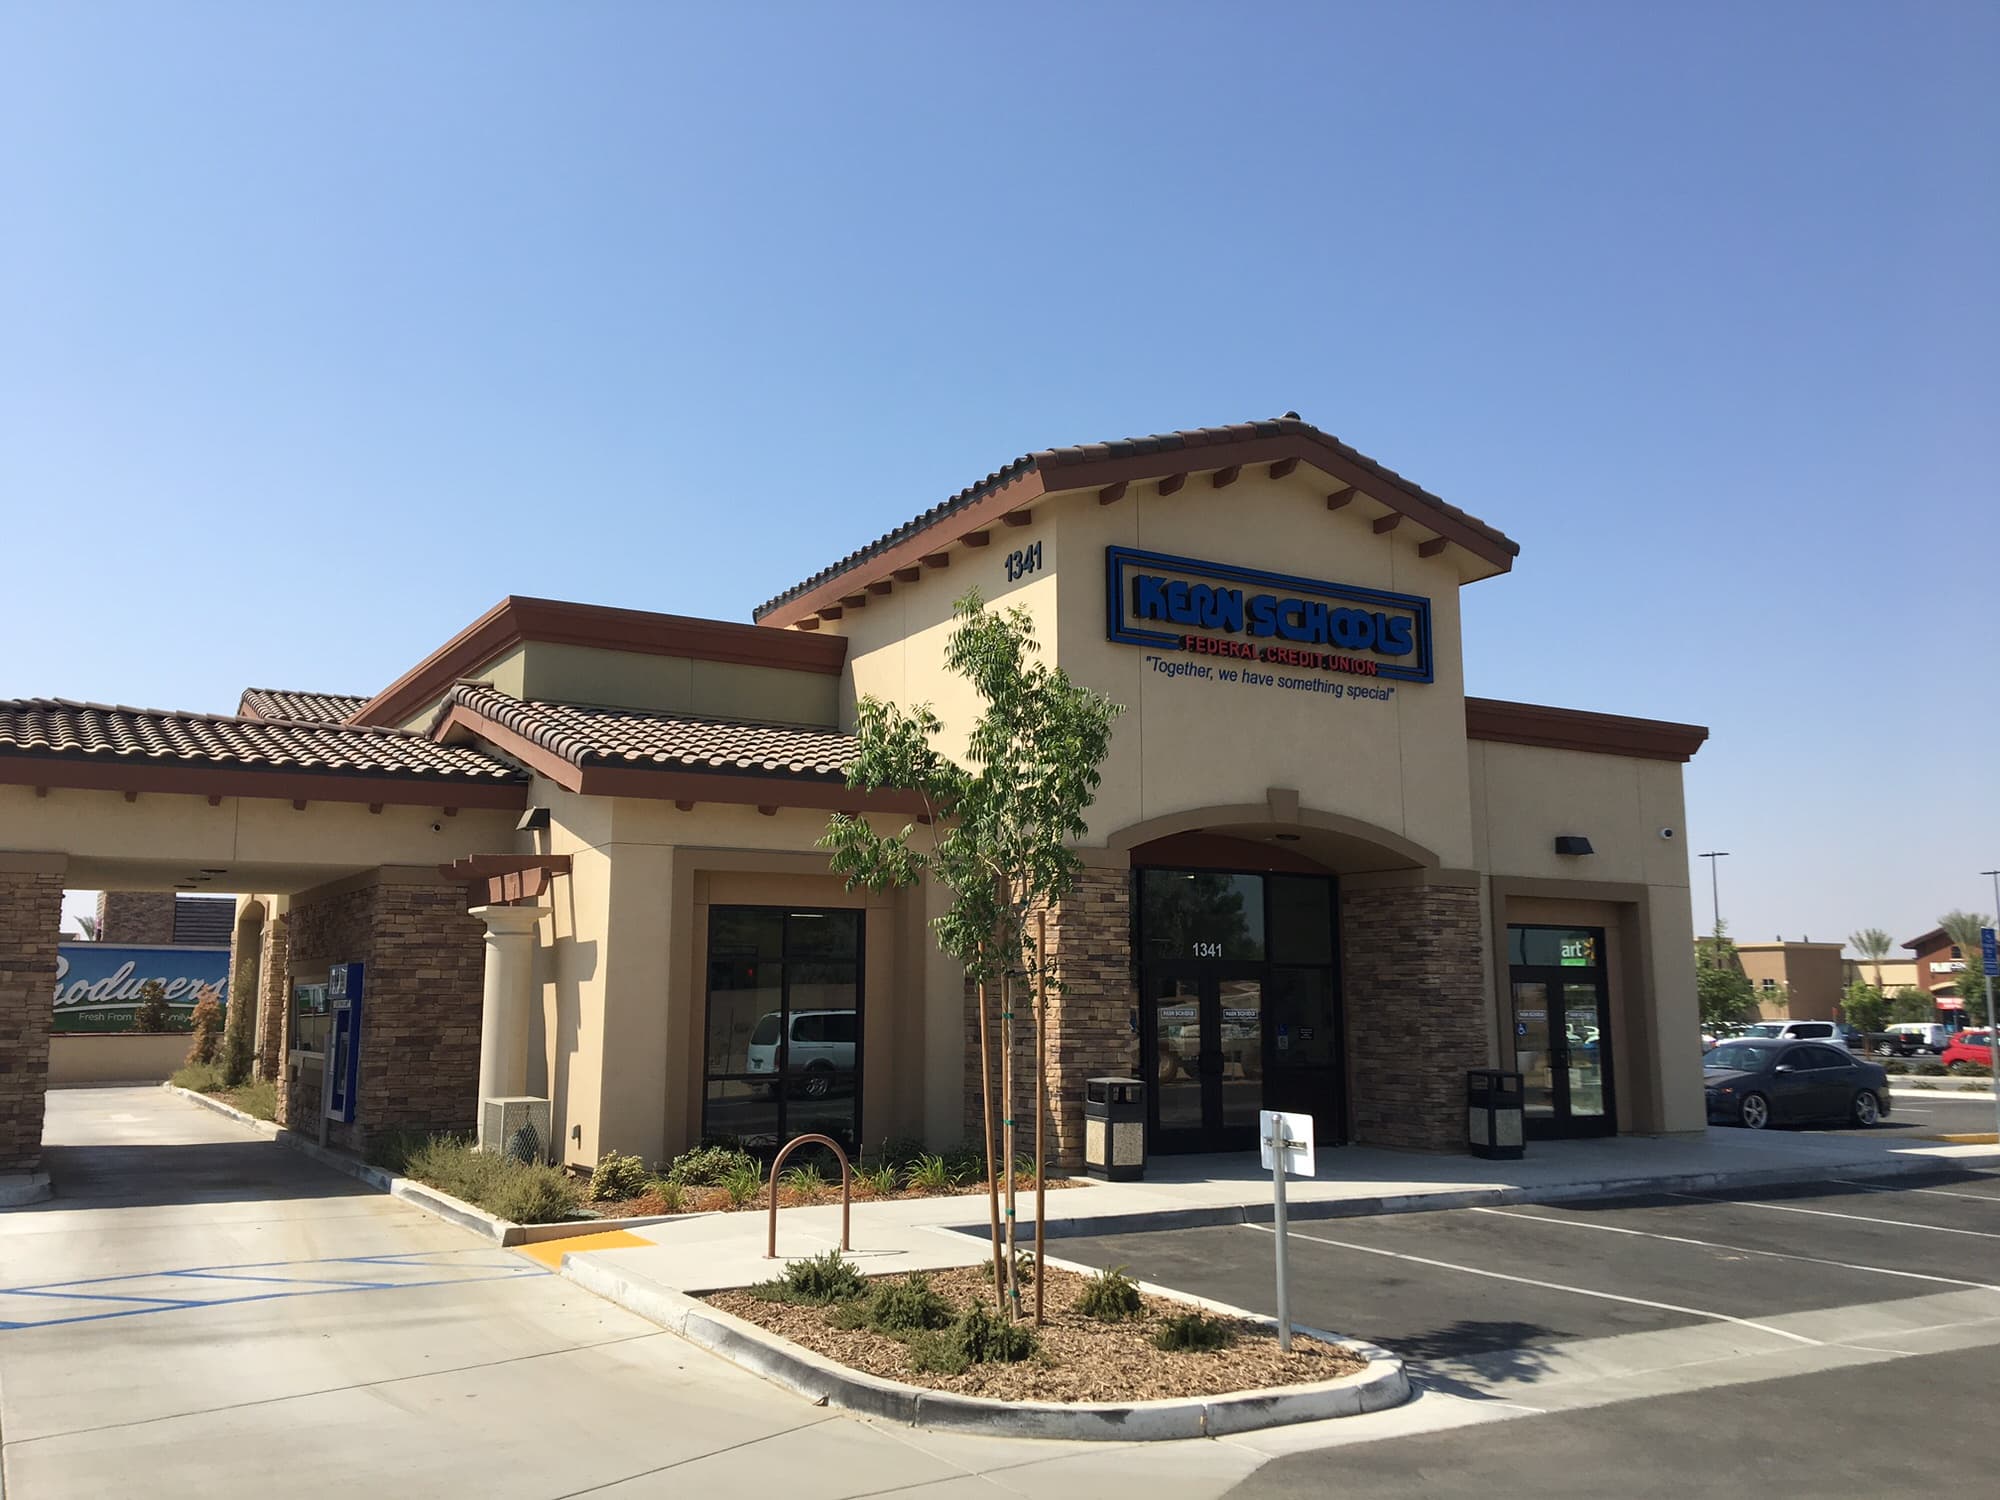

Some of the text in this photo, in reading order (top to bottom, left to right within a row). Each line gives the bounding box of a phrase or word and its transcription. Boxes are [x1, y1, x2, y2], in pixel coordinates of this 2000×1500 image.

[1004, 540, 1042, 582] 1341
[1133, 574, 1414, 657] KERN SCHOOLS
[1183, 634, 1377, 676] FEDERAL CREDIT UNION
[1146, 655, 1395, 701] "Together, we have something special"
[1192, 942, 1222, 957] 1341
[78, 1012, 105, 1021] Fresh
[107, 1012, 132, 1021] From
